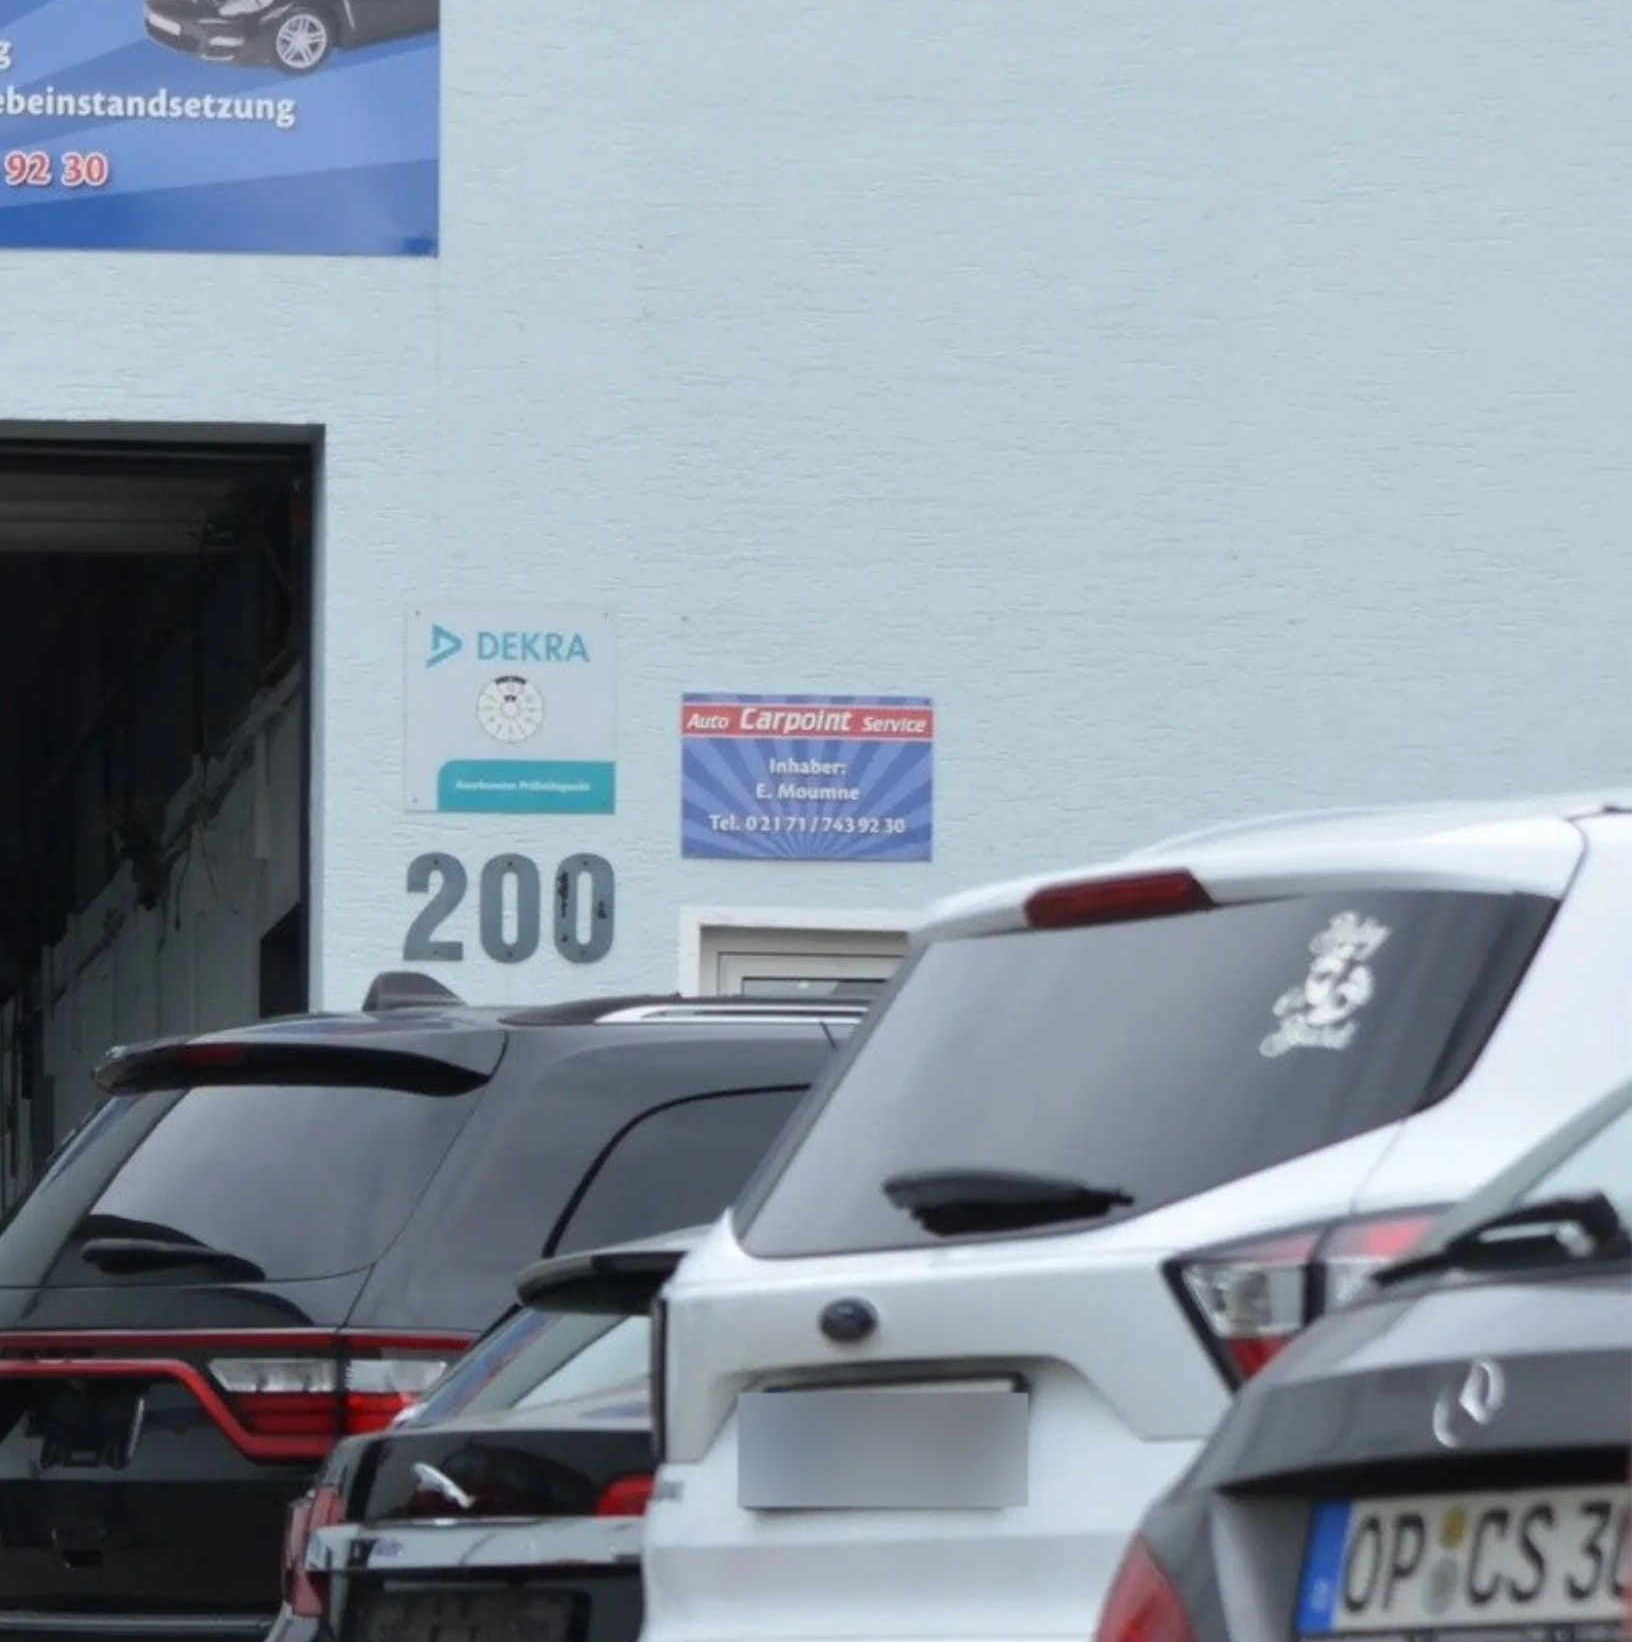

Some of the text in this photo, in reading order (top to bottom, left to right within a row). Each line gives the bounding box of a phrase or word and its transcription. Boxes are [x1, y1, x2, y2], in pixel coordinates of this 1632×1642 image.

[4, 150, 52, 186] 92
[61, 151, 109, 187] 30
[476, 631, 591, 663] DEKRA
[686, 707, 927, 734] Auto Carpoint Service
[769, 757, 848, 776] Inhaber:
[756, 782, 772, 800] E.
[709, 814, 742, 832] Tel.
[883, 818, 907, 835] 30
[403, 851, 616, 965] 200
